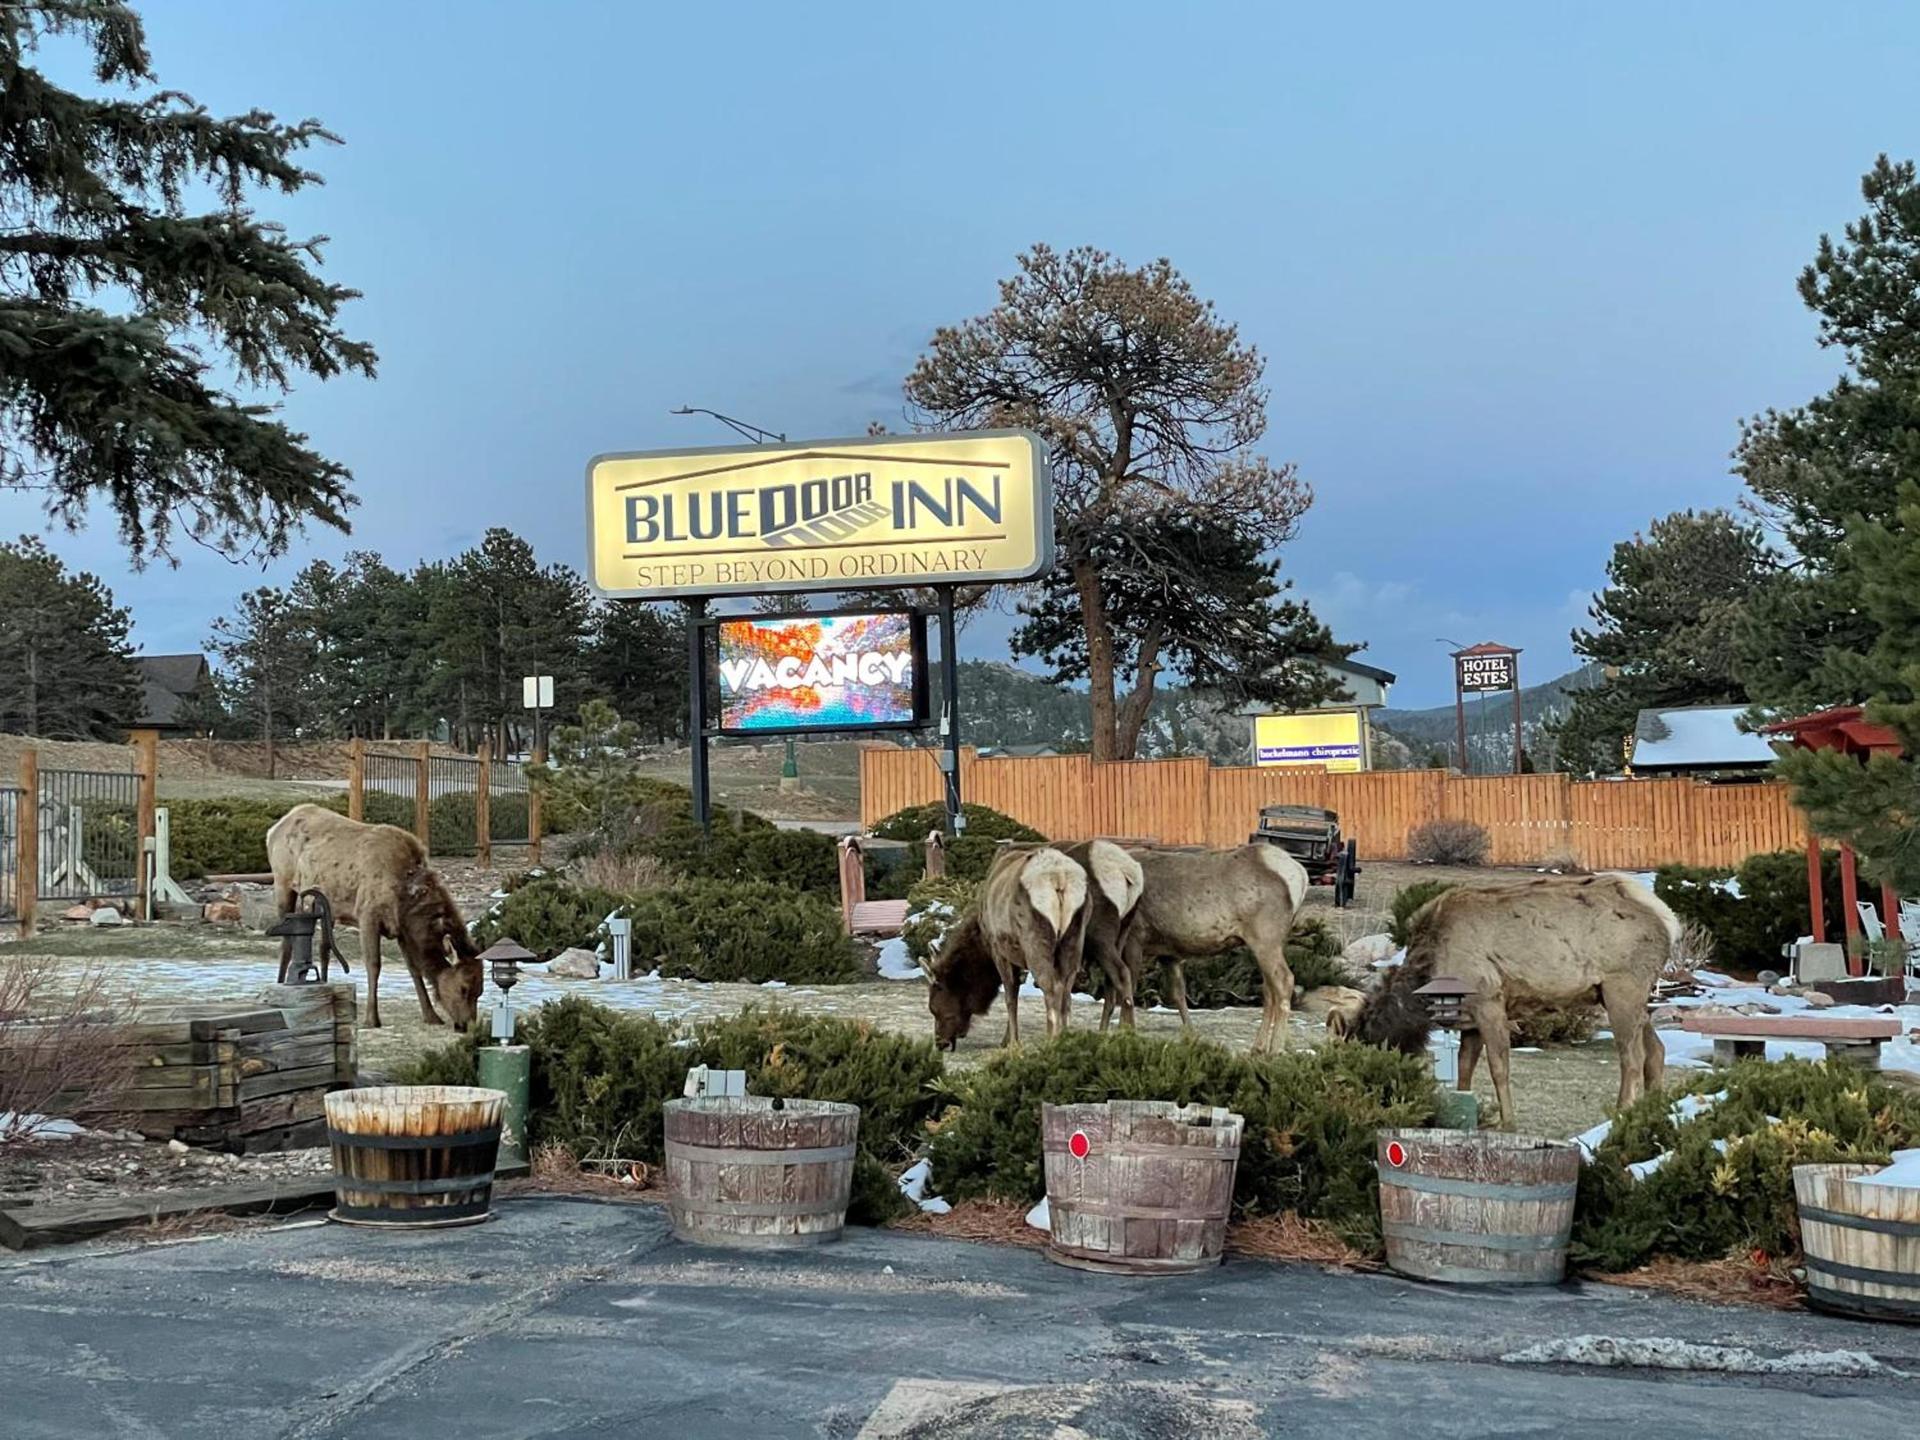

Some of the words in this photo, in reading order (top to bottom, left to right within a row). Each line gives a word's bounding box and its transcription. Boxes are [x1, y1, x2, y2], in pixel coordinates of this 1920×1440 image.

[892, 474, 1002, 530] INN
[637, 563, 705, 588] STEP
[716, 556, 829, 584] BEYOND
[839, 548, 988, 577] ORDINARY
[719, 651, 912, 694] VACANCY
[1463, 658, 1508, 672] HOTEL
[1463, 671, 1509, 686] ESTES
[1311, 746, 1360, 758] chiropractic
